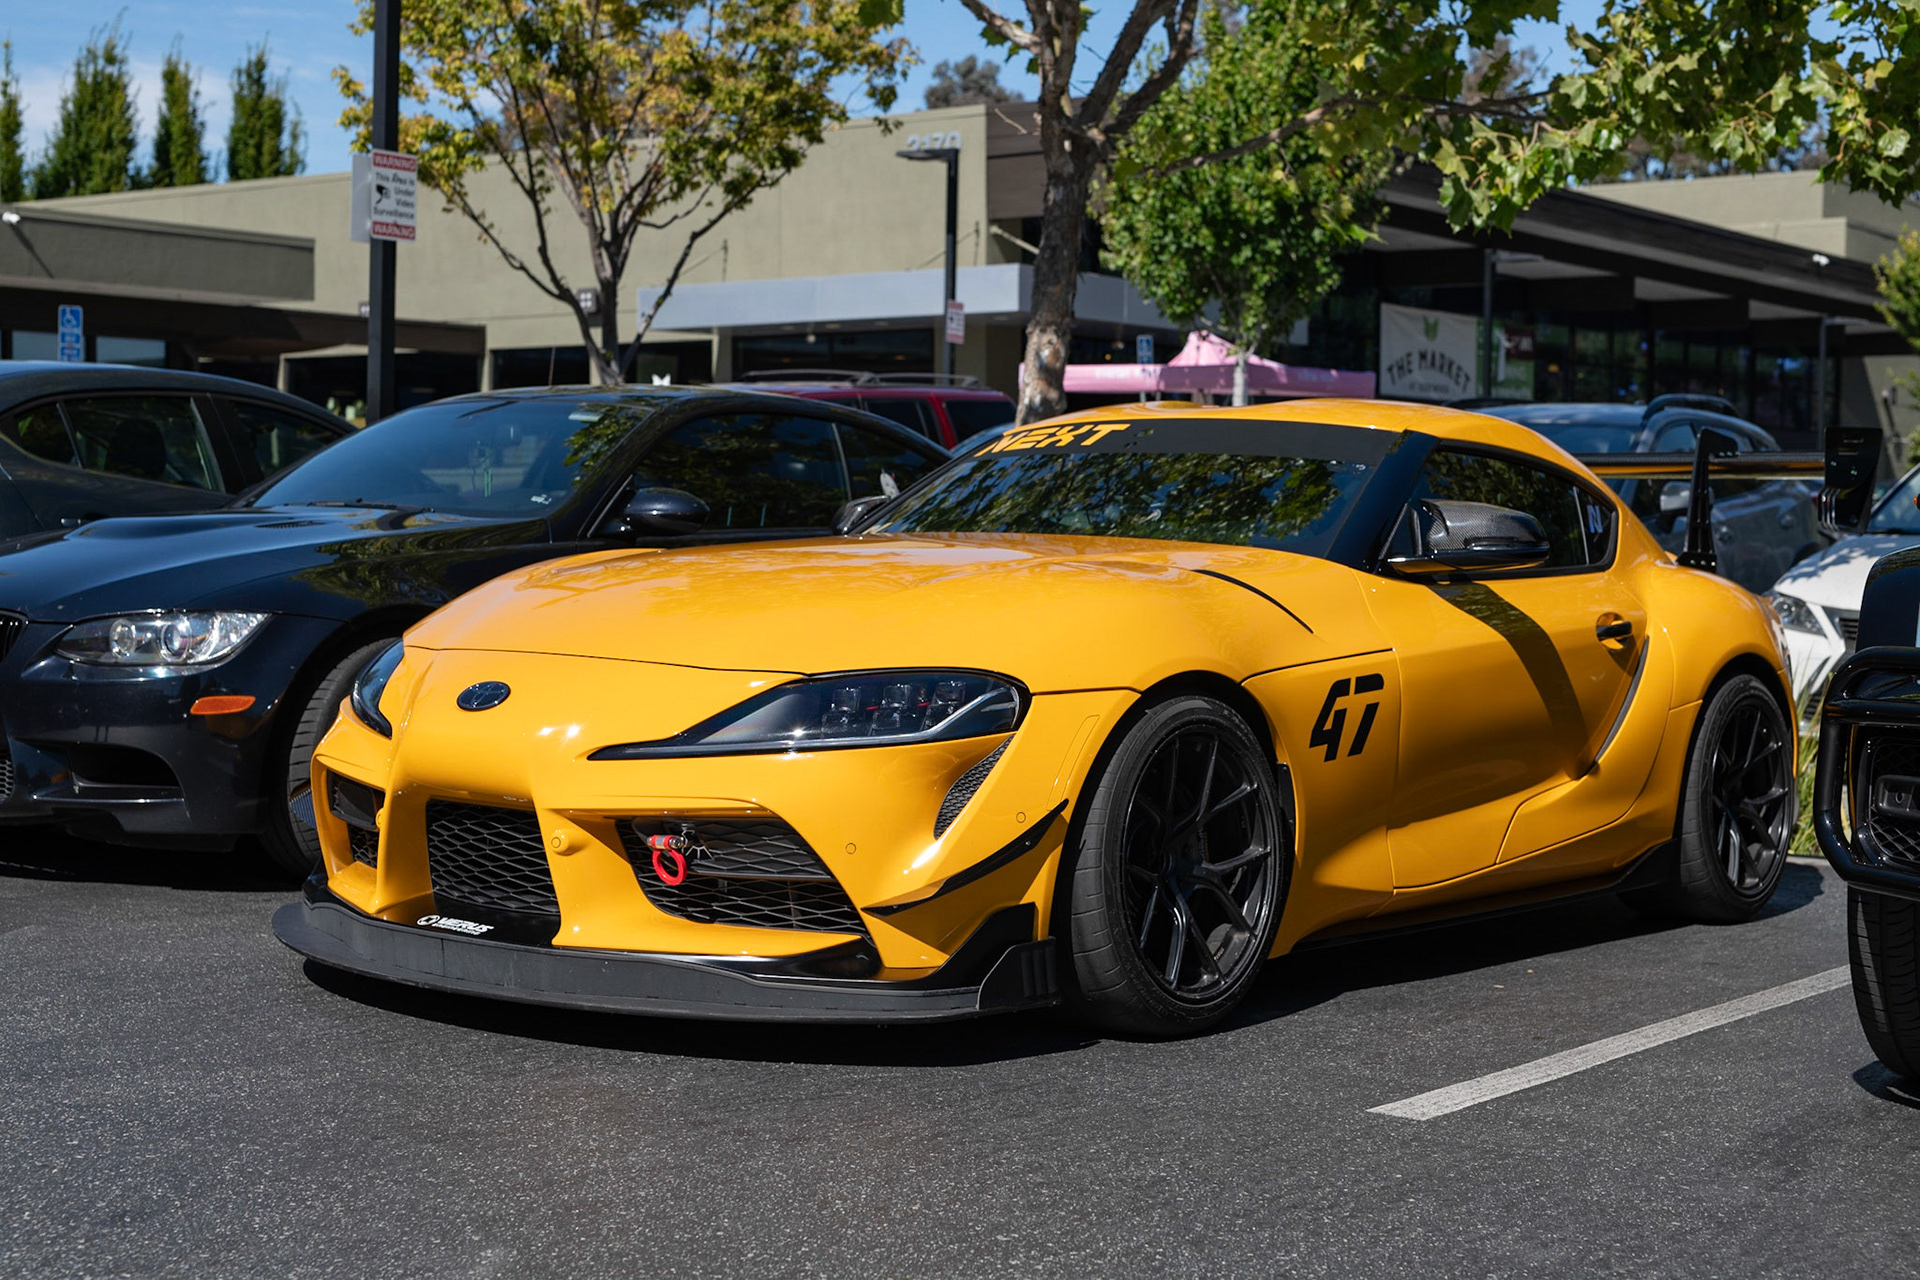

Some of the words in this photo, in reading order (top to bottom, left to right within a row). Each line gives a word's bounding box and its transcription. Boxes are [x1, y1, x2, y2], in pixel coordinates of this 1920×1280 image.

[374, 154, 415, 171] WARNING
[394, 187, 415, 196] Under
[396, 199, 415, 208] Video
[373, 206, 415, 219] Surveillance
[373, 223, 415, 240] WARNING
[1387, 351, 1413, 386] THE
[1418, 348, 1471, 393] MARKET
[974, 423, 1131, 458] NEXT
[1309, 673, 1385, 763] 47
